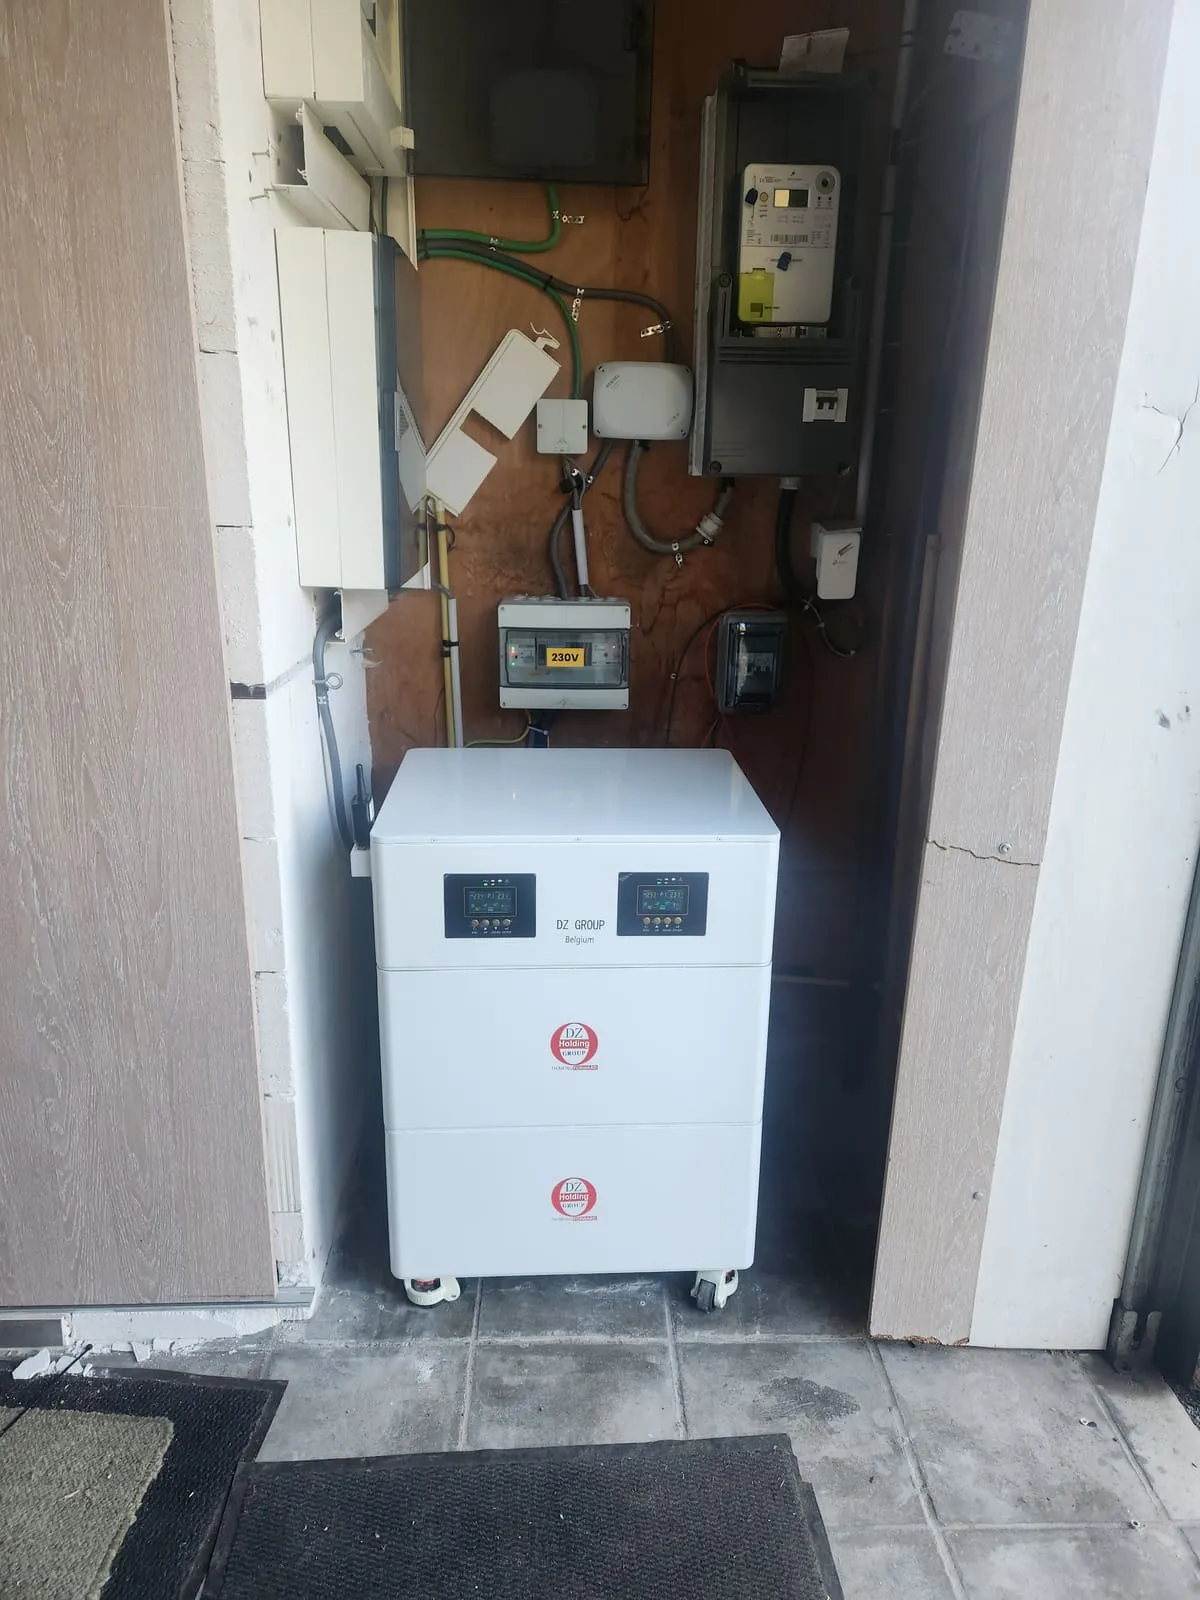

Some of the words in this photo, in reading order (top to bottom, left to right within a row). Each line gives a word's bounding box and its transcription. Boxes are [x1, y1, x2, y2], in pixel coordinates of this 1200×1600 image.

[551, 653, 579, 662] 230V
[556, 919, 569, 930] DZ
[574, 919, 606, 930] GROUP
[565, 935, 595, 945] Belgium
[566, 1027, 583, 1039] DZ
[559, 1039, 590, 1050] Holding
[565, 1182, 583, 1193] DZ
[559, 1193, 589, 1202] Holding
